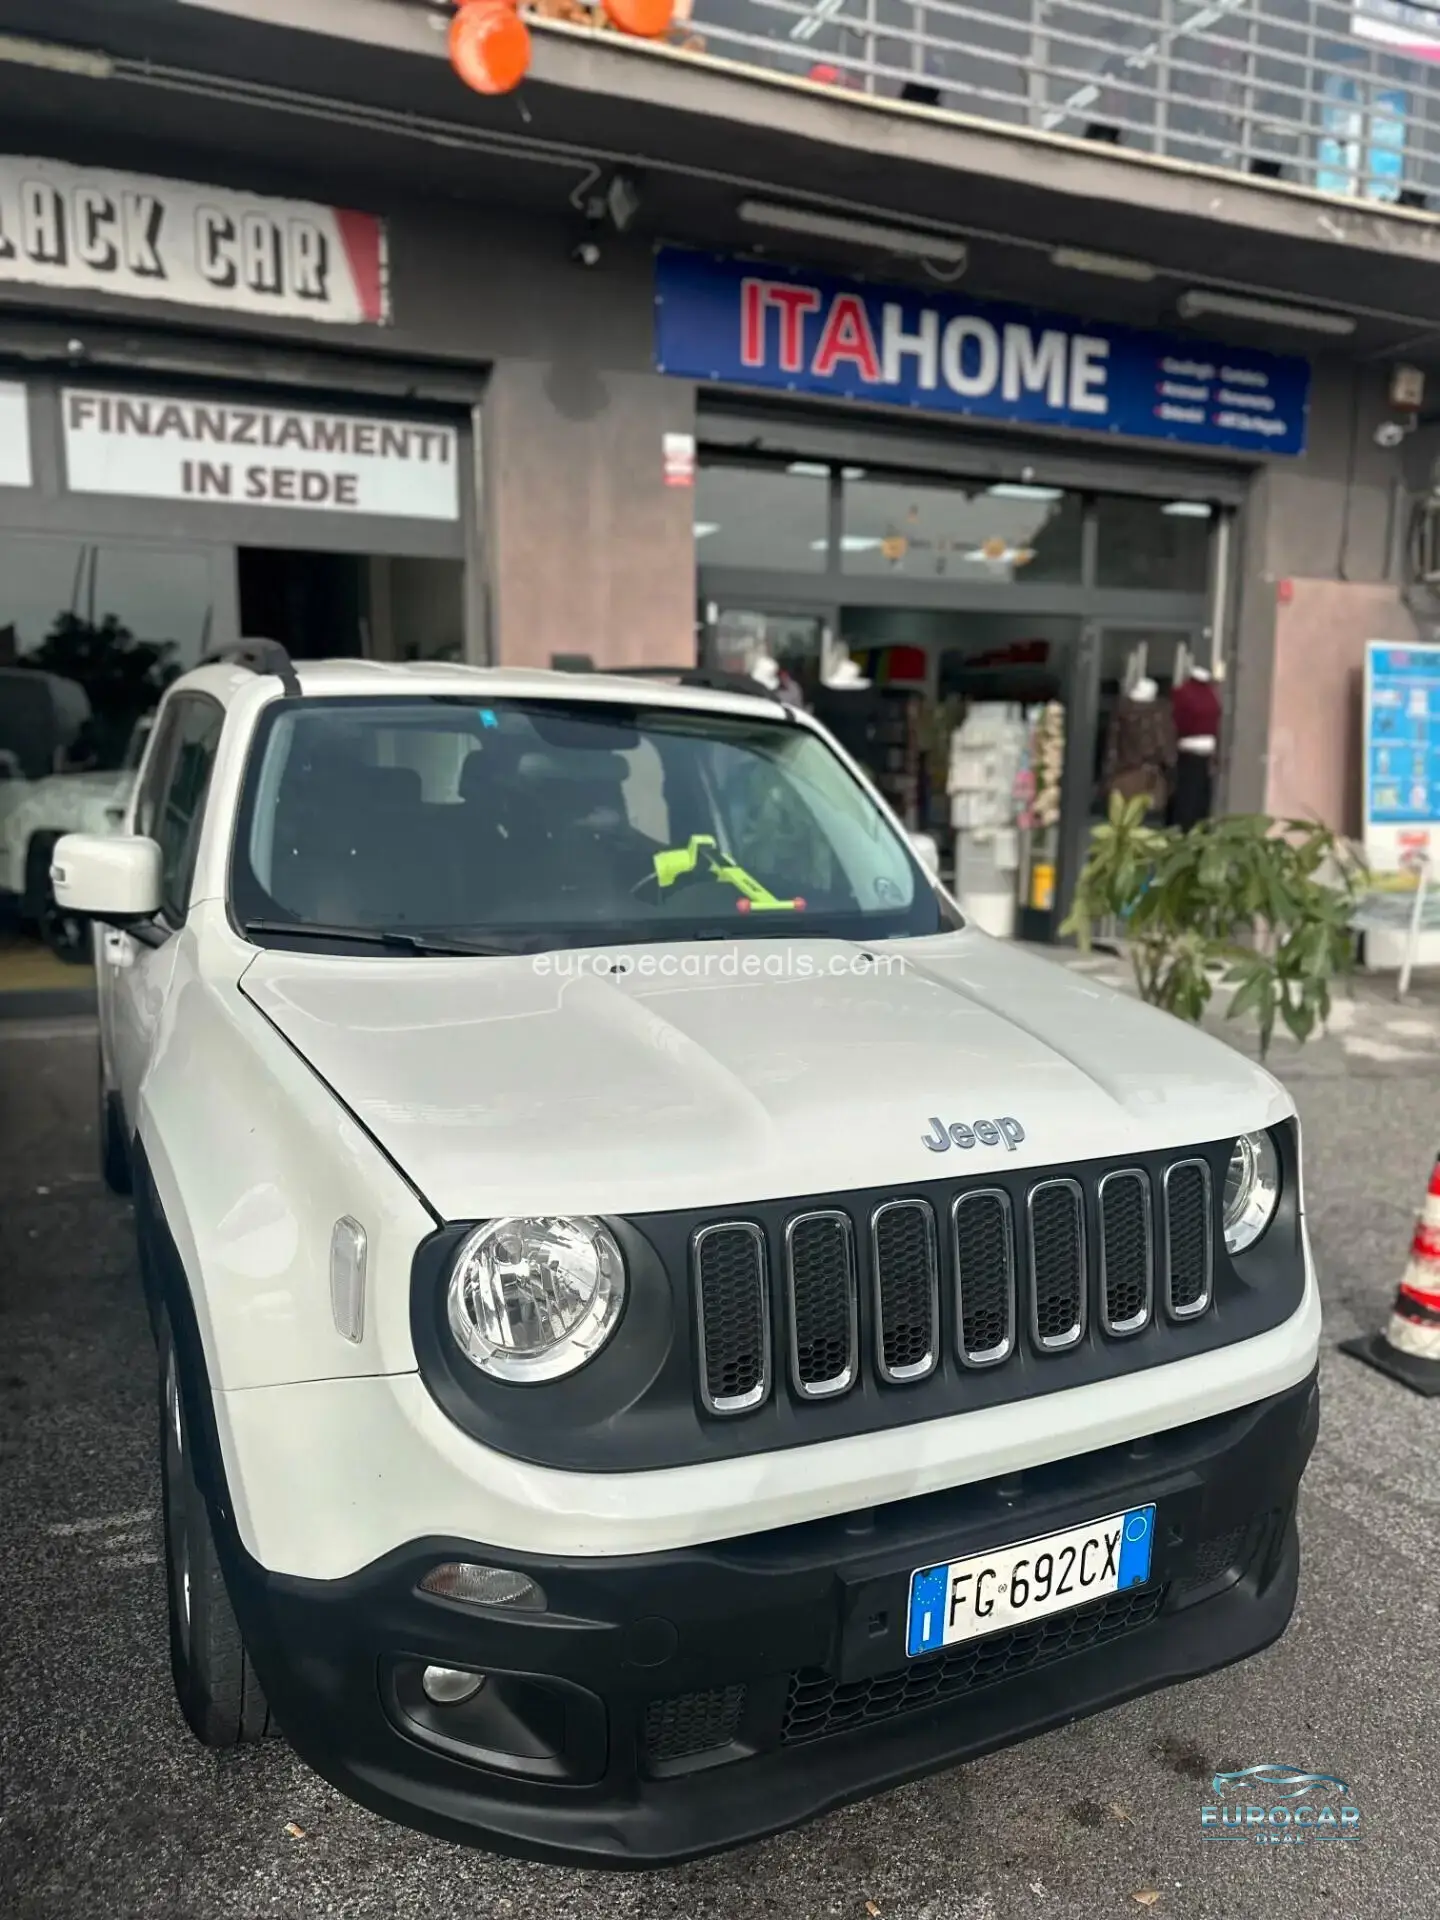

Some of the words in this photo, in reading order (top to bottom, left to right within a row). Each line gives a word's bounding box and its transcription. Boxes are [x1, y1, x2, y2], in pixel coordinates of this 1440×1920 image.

[192, 203, 330, 302] CAR
[740, 277, 1110, 414] ITAHOME
[68, 394, 451, 464] FINANZIAMENTI
[181, 459, 232, 496] IN
[244, 465, 359, 506] SEDE
[920, 1116, 1026, 1153] Jeep
